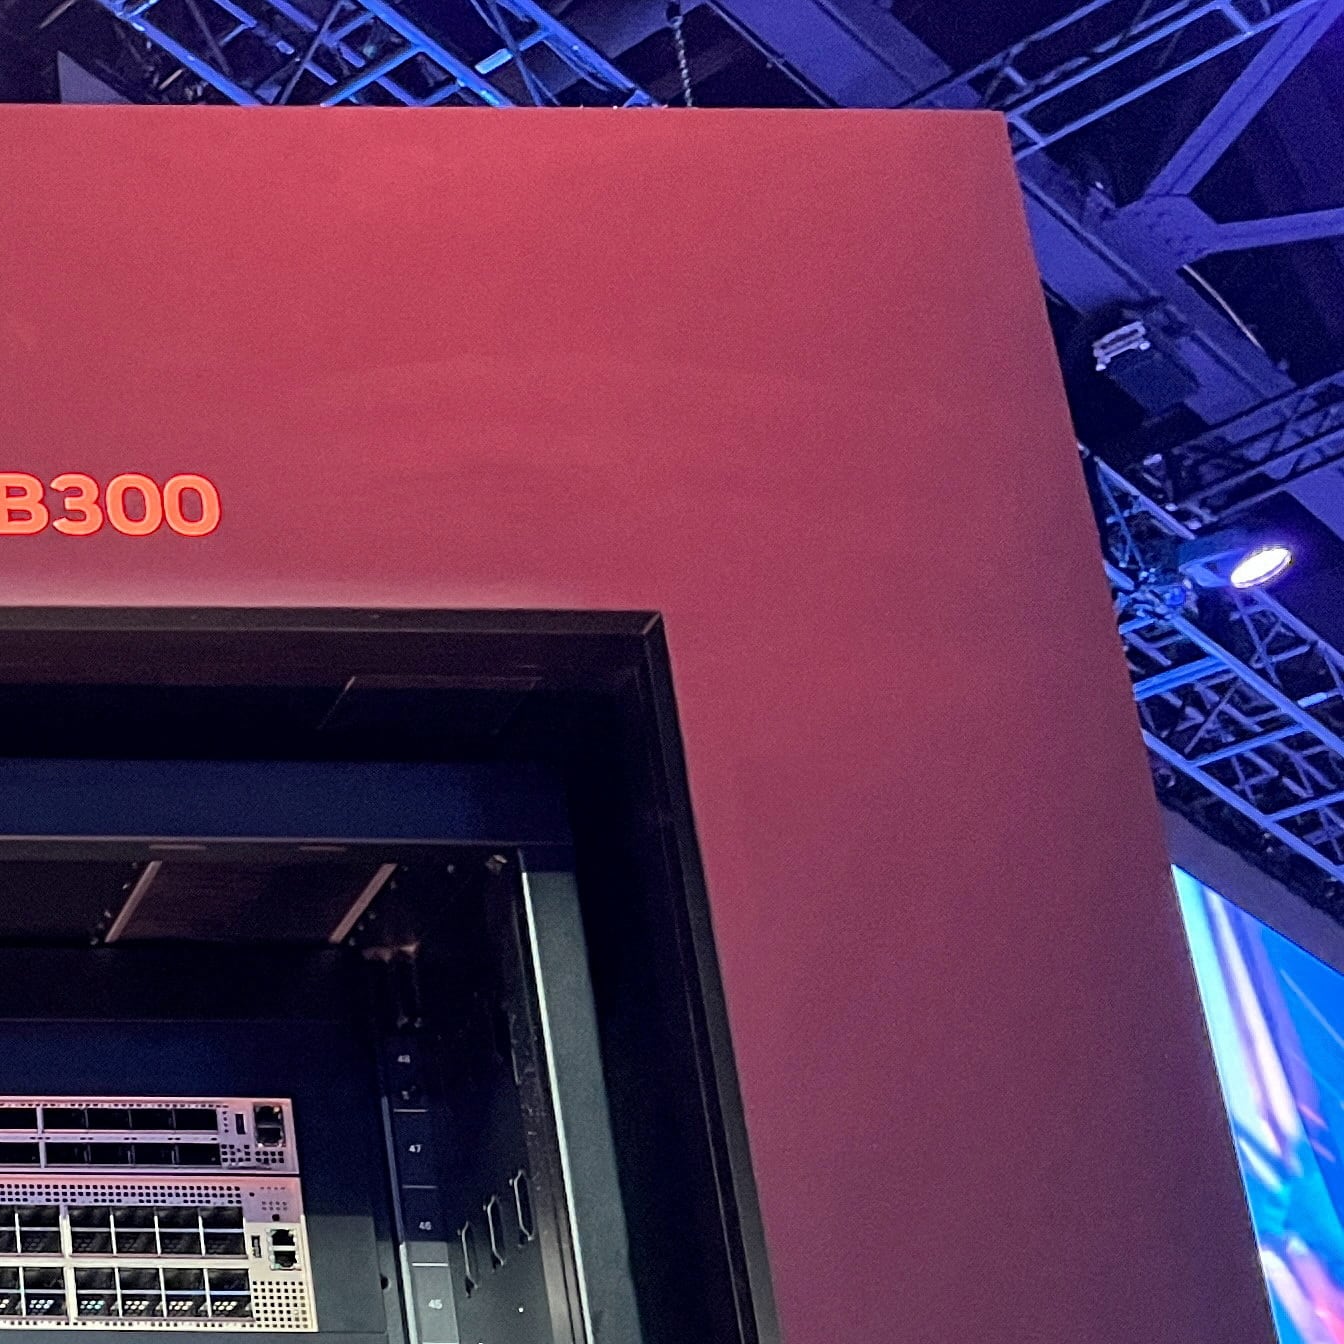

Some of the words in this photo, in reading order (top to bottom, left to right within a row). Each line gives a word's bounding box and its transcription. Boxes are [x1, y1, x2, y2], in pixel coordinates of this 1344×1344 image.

[409, 1144, 422, 1153] 47
[418, 1221, 432, 1231] 46
[428, 1299, 443, 1310] 45
